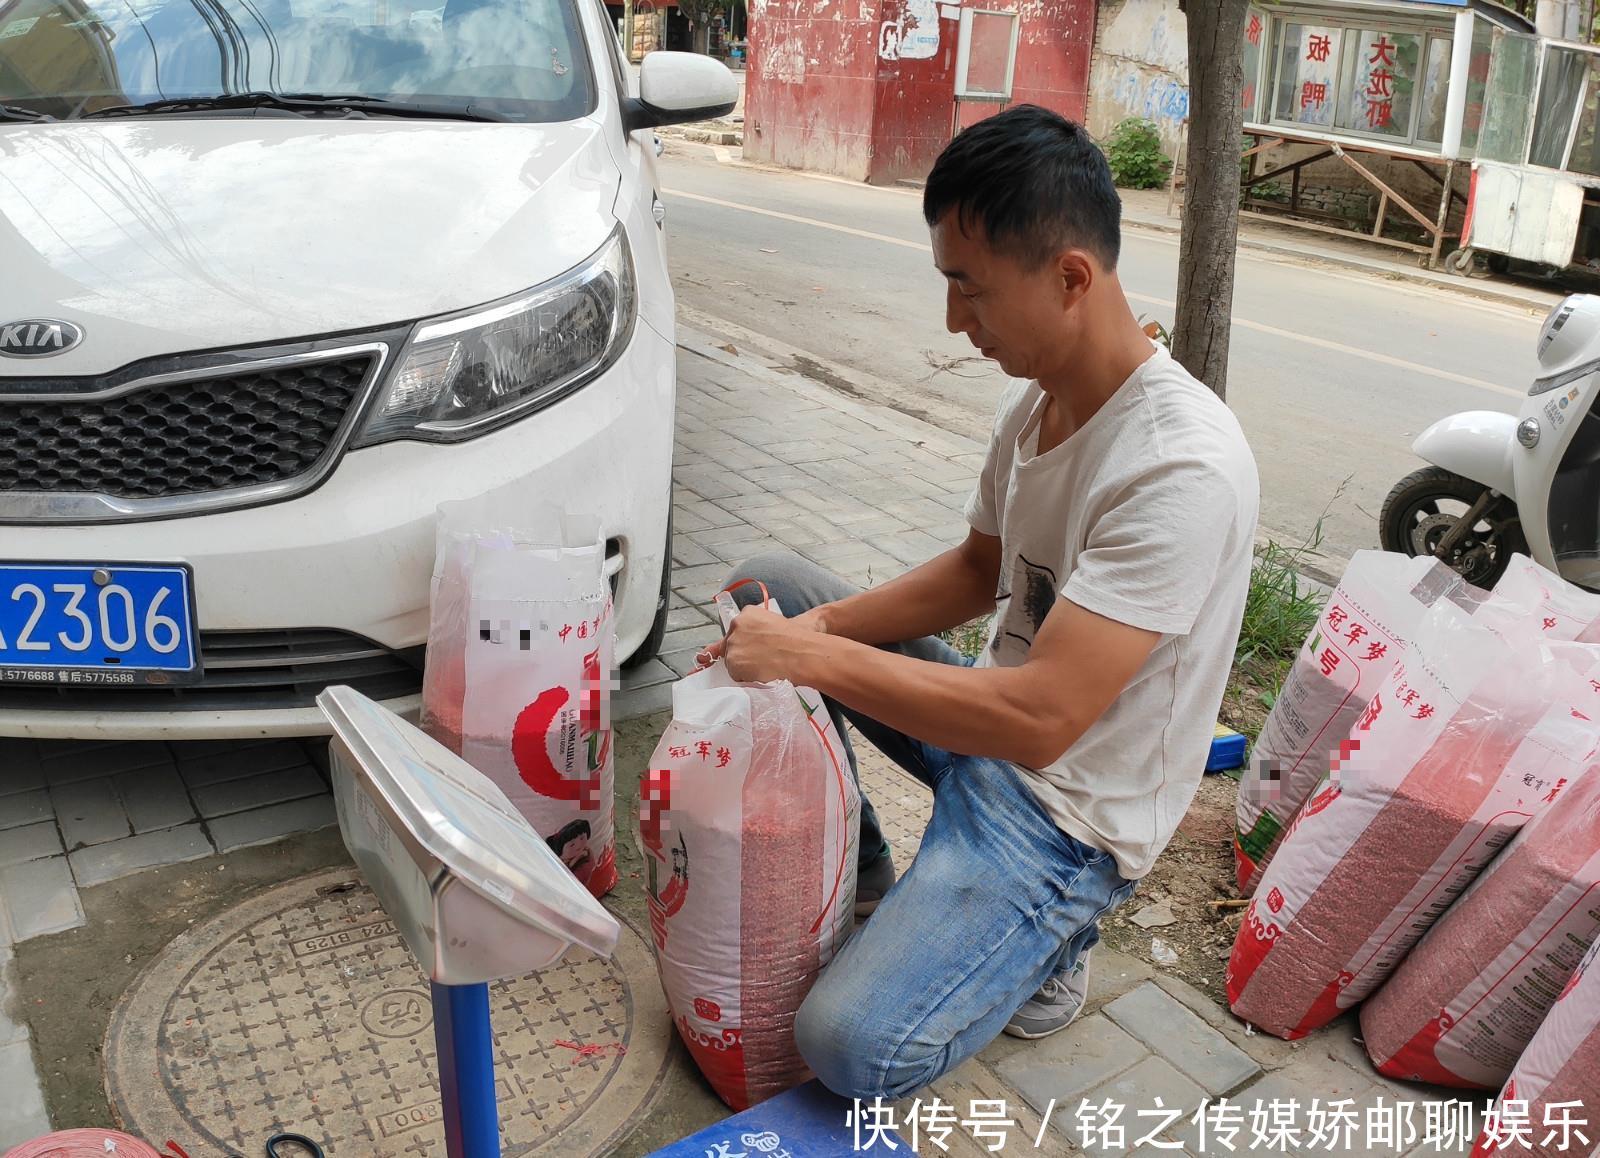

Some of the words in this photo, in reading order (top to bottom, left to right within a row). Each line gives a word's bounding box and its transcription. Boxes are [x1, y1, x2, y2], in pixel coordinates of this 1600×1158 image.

[0, 324, 63, 347] KIA
[0, 584, 181, 653] 2306
[1326, 605, 1387, 661] 冠军梦
[0, 670, 55, 681] :5776688
[58, 670, 134, 683] 售后:5775588
[668, 741, 732, 768] 冠军梦
[305, 932, 351, 951] B125
